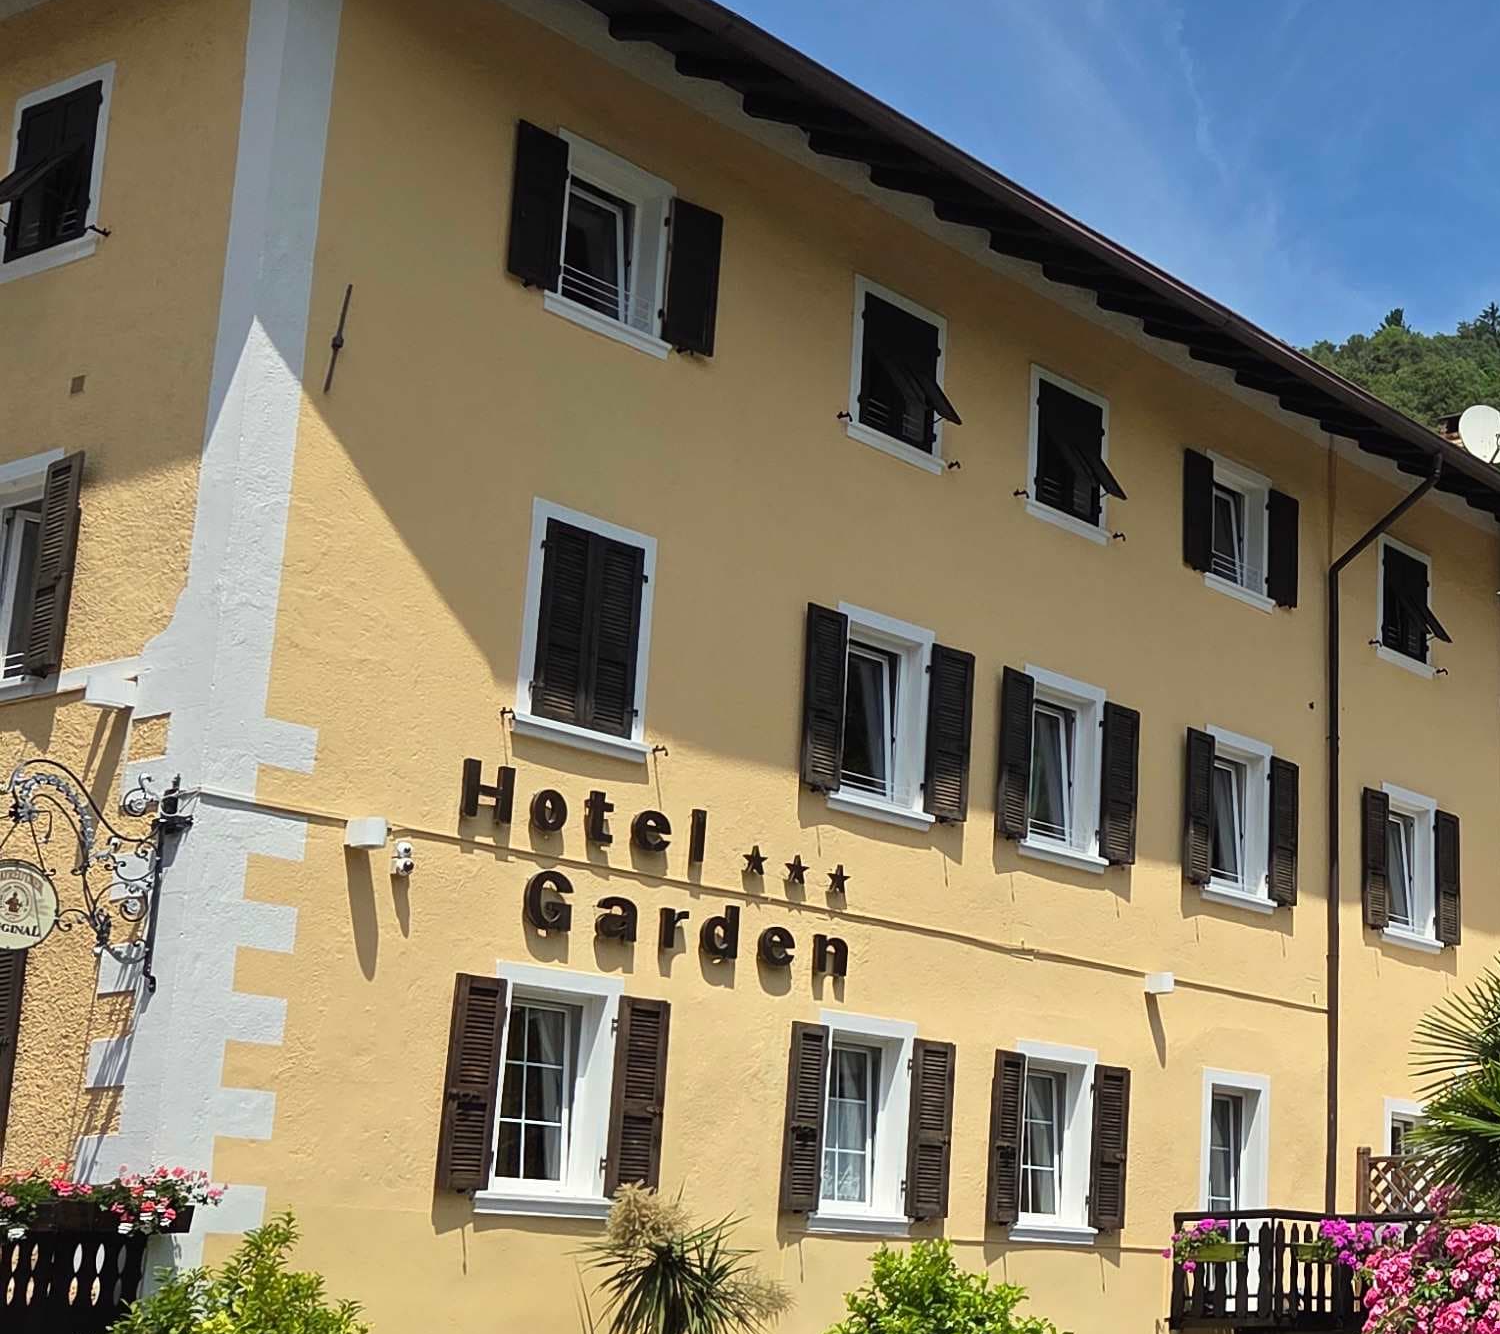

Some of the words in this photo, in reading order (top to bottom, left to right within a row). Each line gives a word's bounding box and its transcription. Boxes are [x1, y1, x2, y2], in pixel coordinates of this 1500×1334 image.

[461, 757, 708, 864] Hotel
[0, 921, 41, 938] GINAL
[522, 870, 850, 978] Garden
